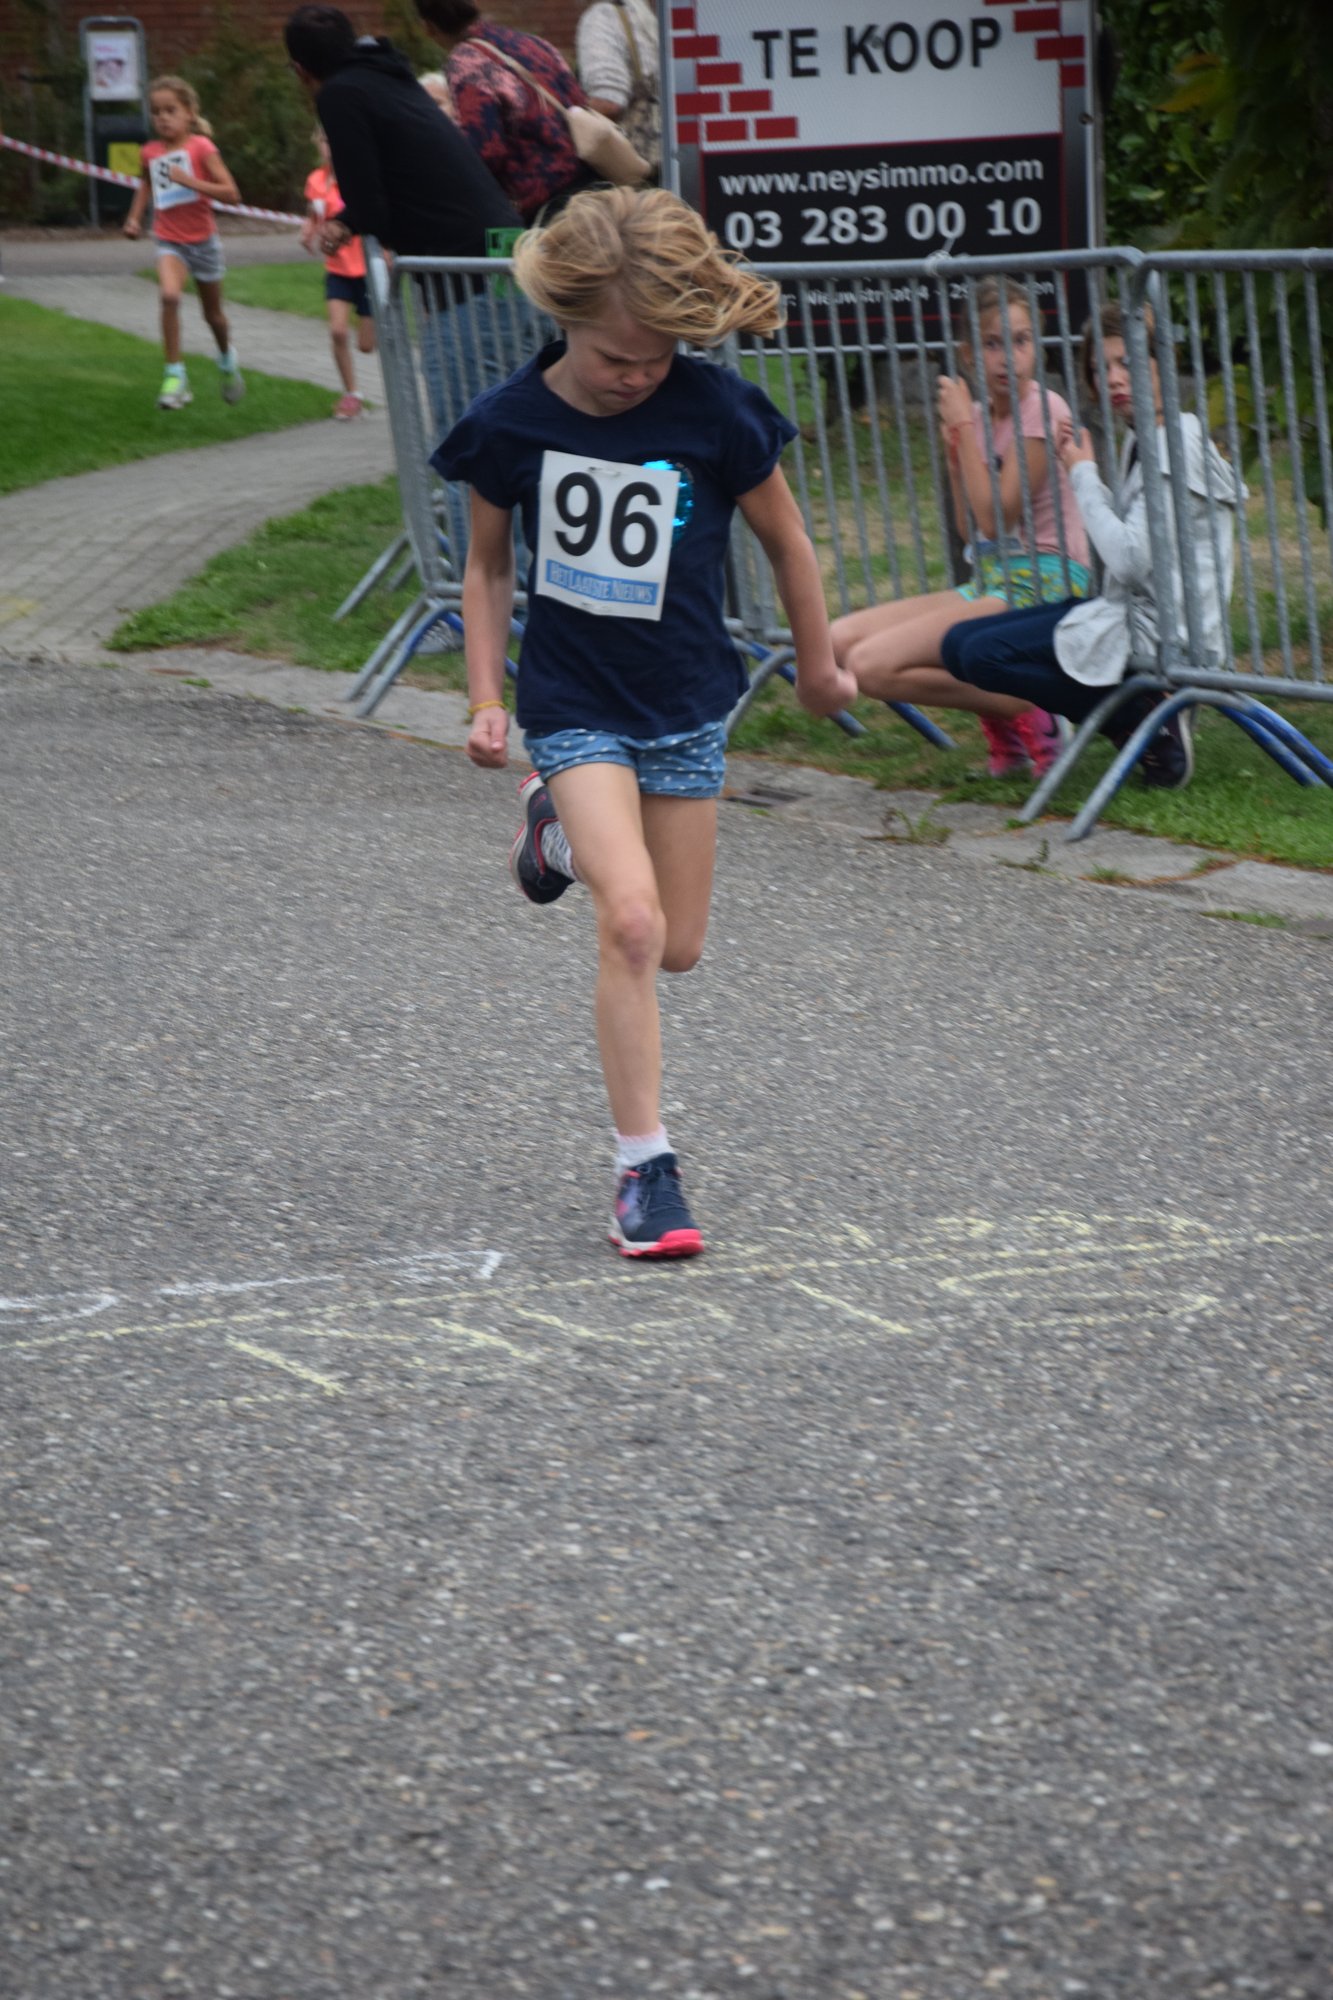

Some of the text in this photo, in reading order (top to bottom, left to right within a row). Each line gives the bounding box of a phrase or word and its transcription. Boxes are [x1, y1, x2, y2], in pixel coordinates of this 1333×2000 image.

[752, 17, 1002, 79] TE KOOP
[719, 158, 1044, 197] www.neysimmo.com
[724, 197, 1042, 250] 03 283 00 10
[554, 471, 662, 567] 96
